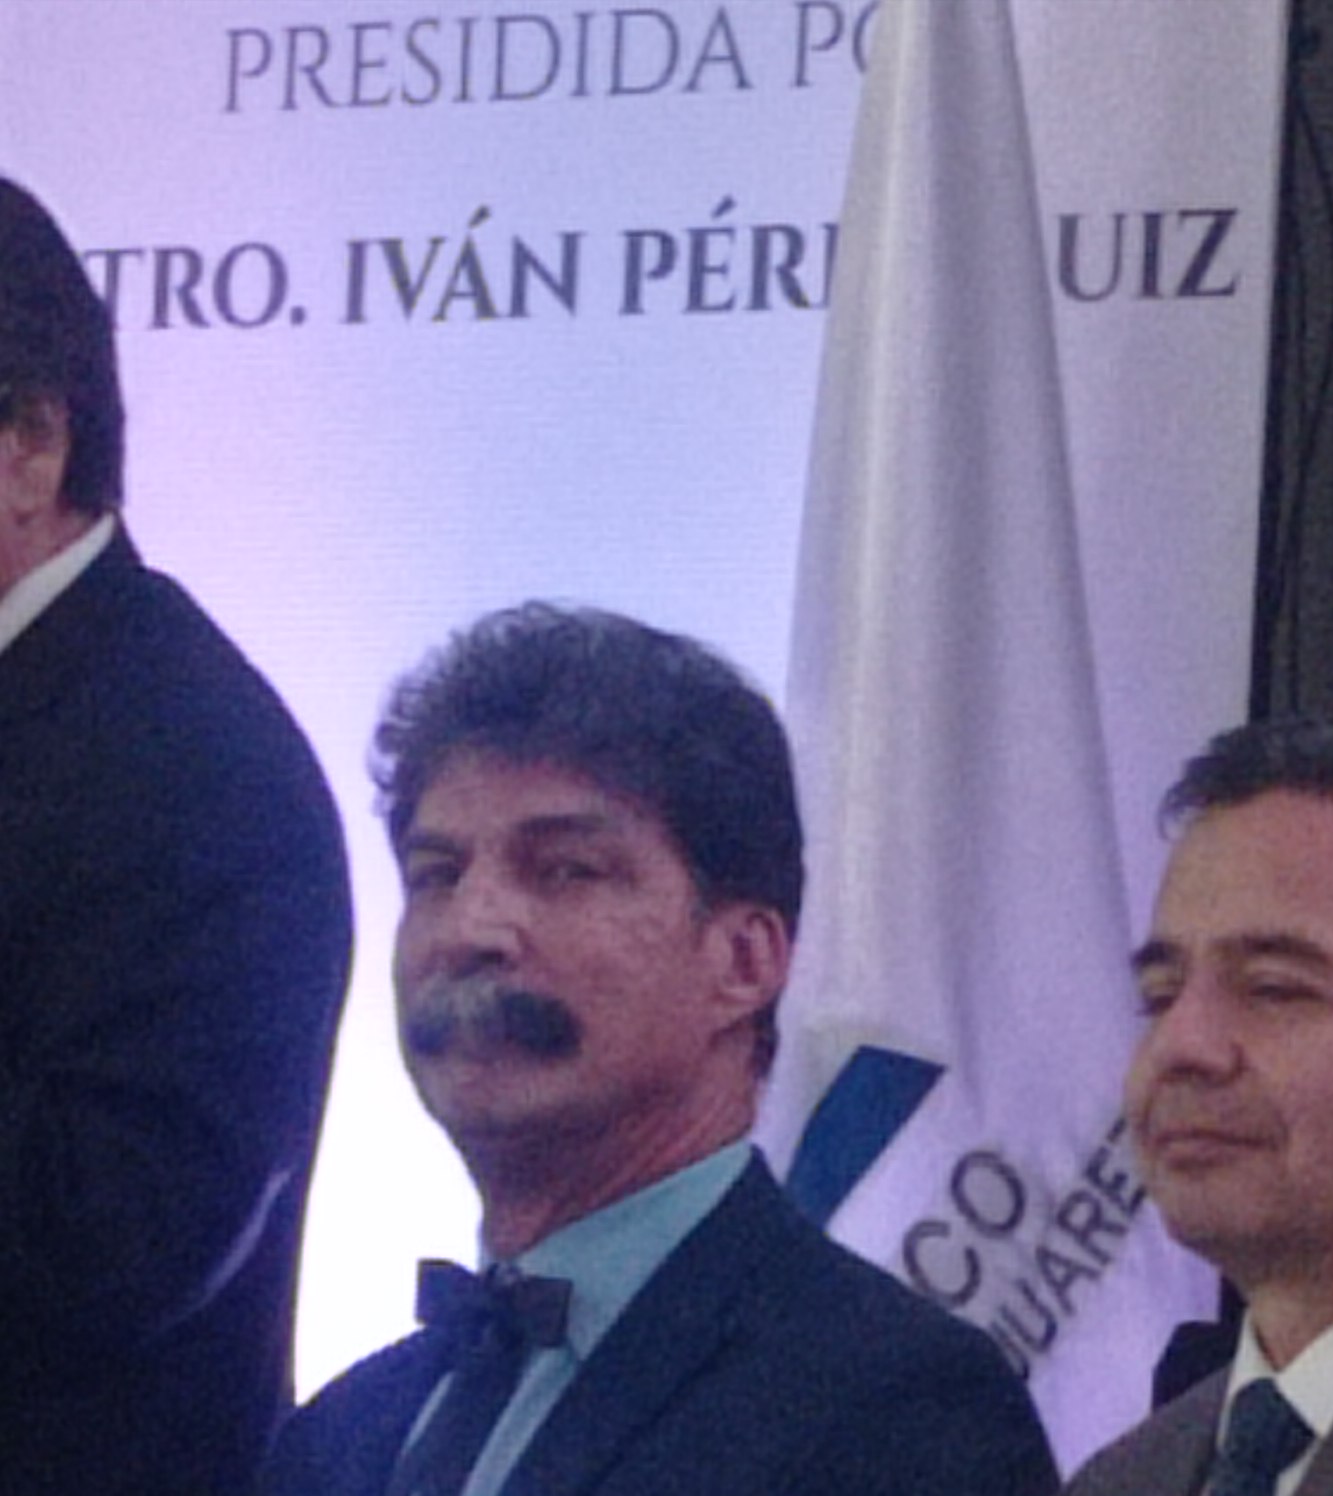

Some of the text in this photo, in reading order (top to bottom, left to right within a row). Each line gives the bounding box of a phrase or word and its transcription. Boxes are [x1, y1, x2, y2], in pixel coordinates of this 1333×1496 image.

[223, 6, 752, 113] PRESIDIDA
[342, 205, 586, 325] IVÁN
[618, 195, 839, 317] PÉR
